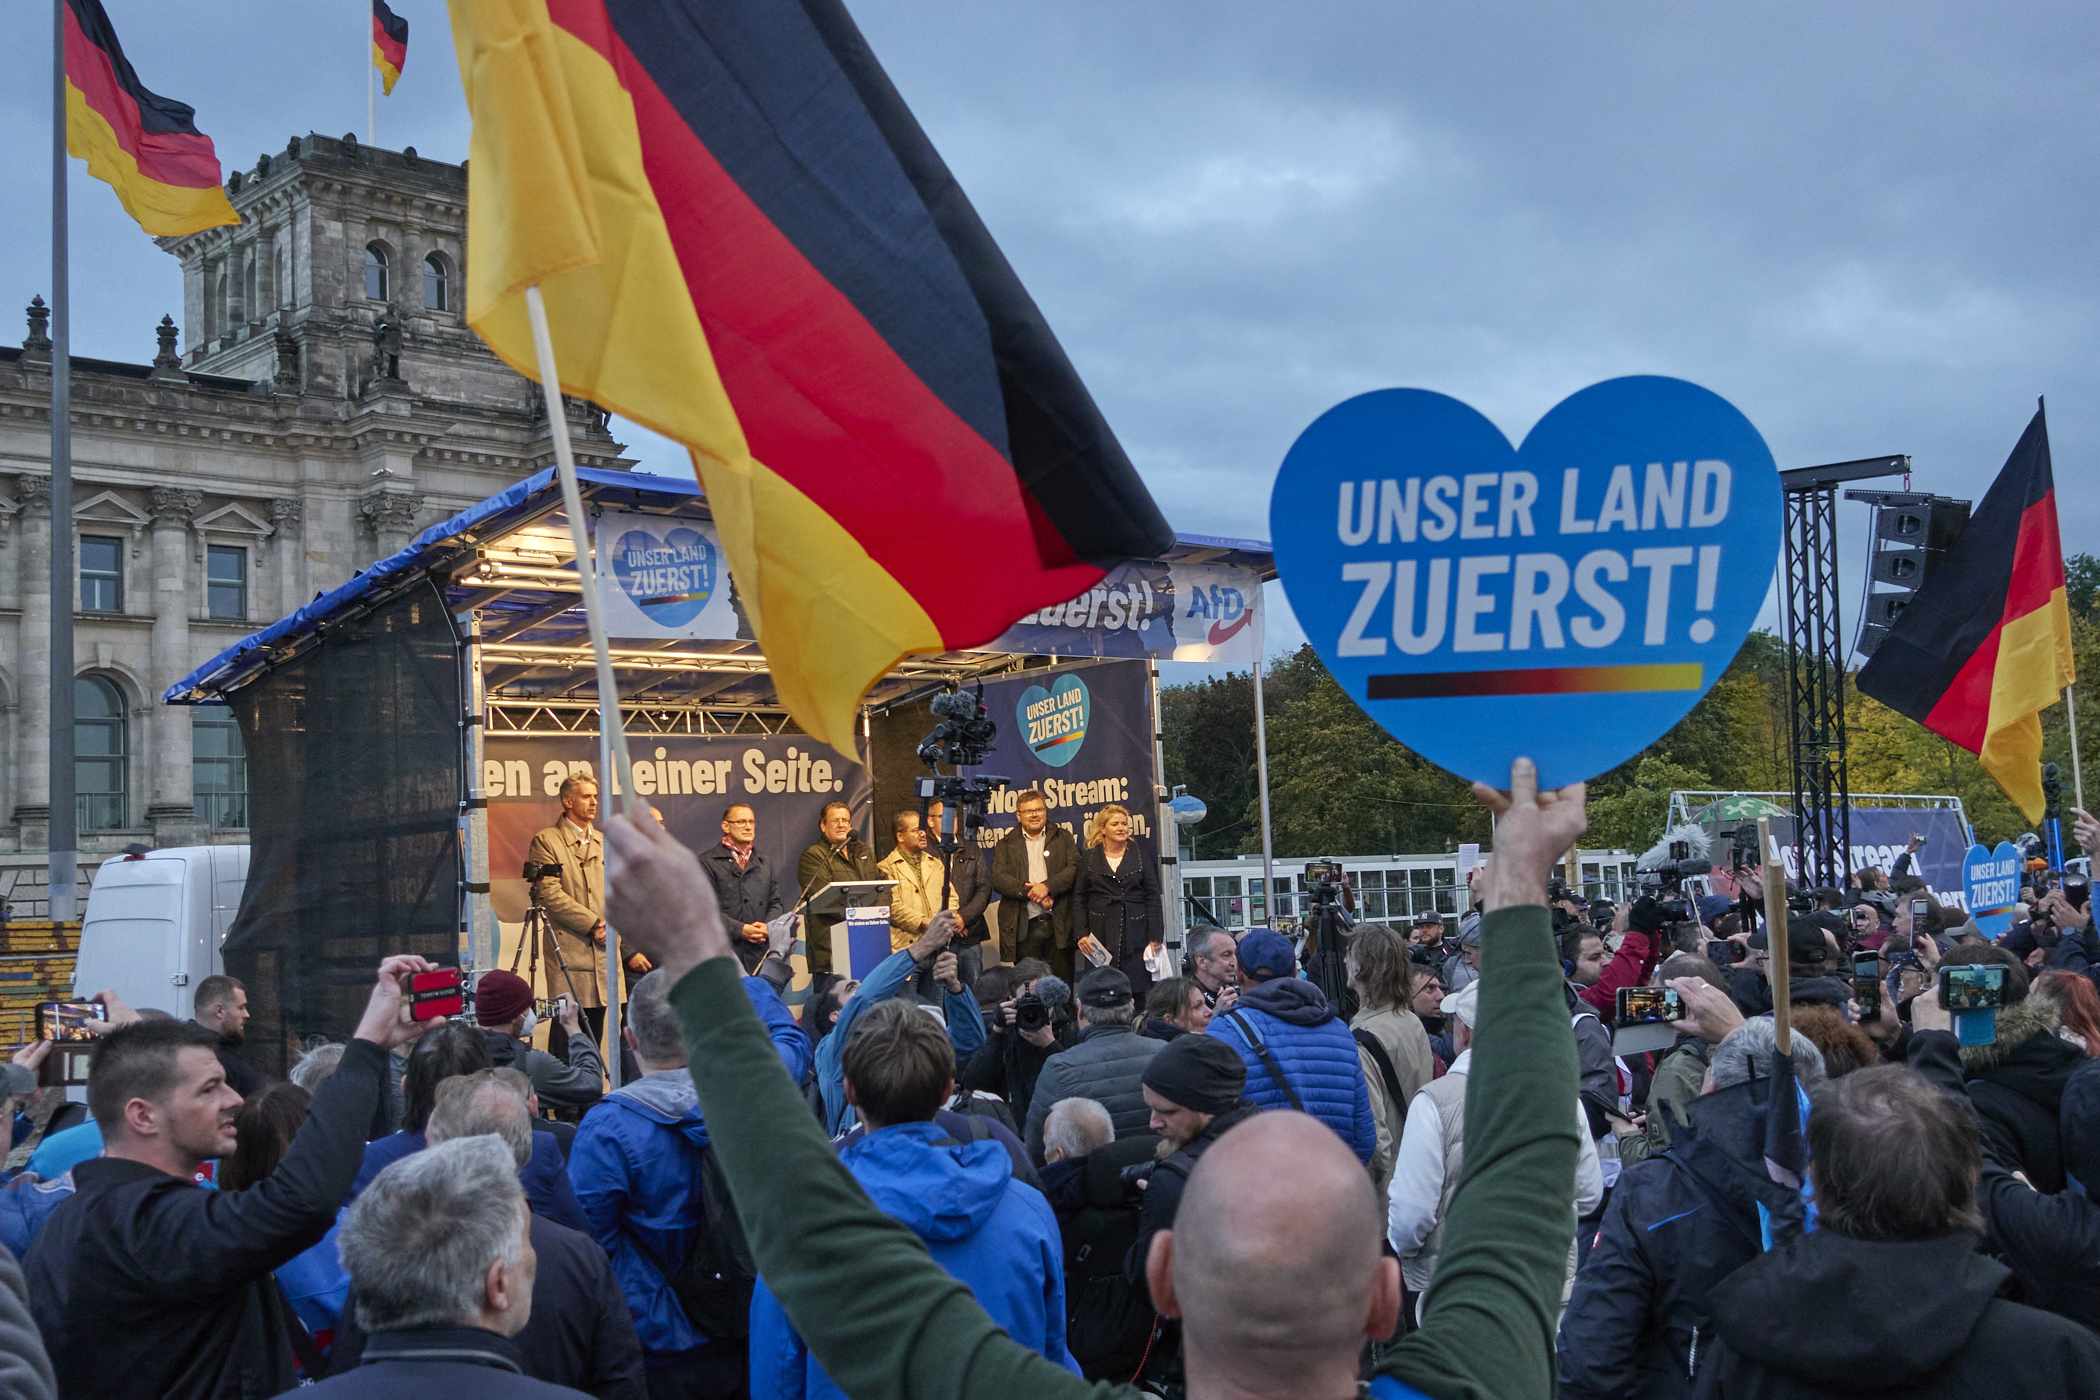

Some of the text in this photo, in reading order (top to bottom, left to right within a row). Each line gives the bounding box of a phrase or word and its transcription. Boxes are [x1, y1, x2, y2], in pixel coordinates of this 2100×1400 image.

[1337, 460, 1732, 546] UNSER LAND
[628, 544, 707, 568] UNSER LAND
[630, 563, 710, 596] ZUERST!
[1186, 584, 1244, 620] AfD
[1337, 545, 1721, 658] ZUERST!
[1027, 688, 1082, 720] UNSER LAND
[1028, 705, 1085, 744] ZUERST!
[742, 746, 844, 795] Seite.
[1043, 776, 1130, 810] Stream:
[1970, 859, 2015, 881] UNSER LAND
[1971, 878, 2015, 908] ZUERST!
